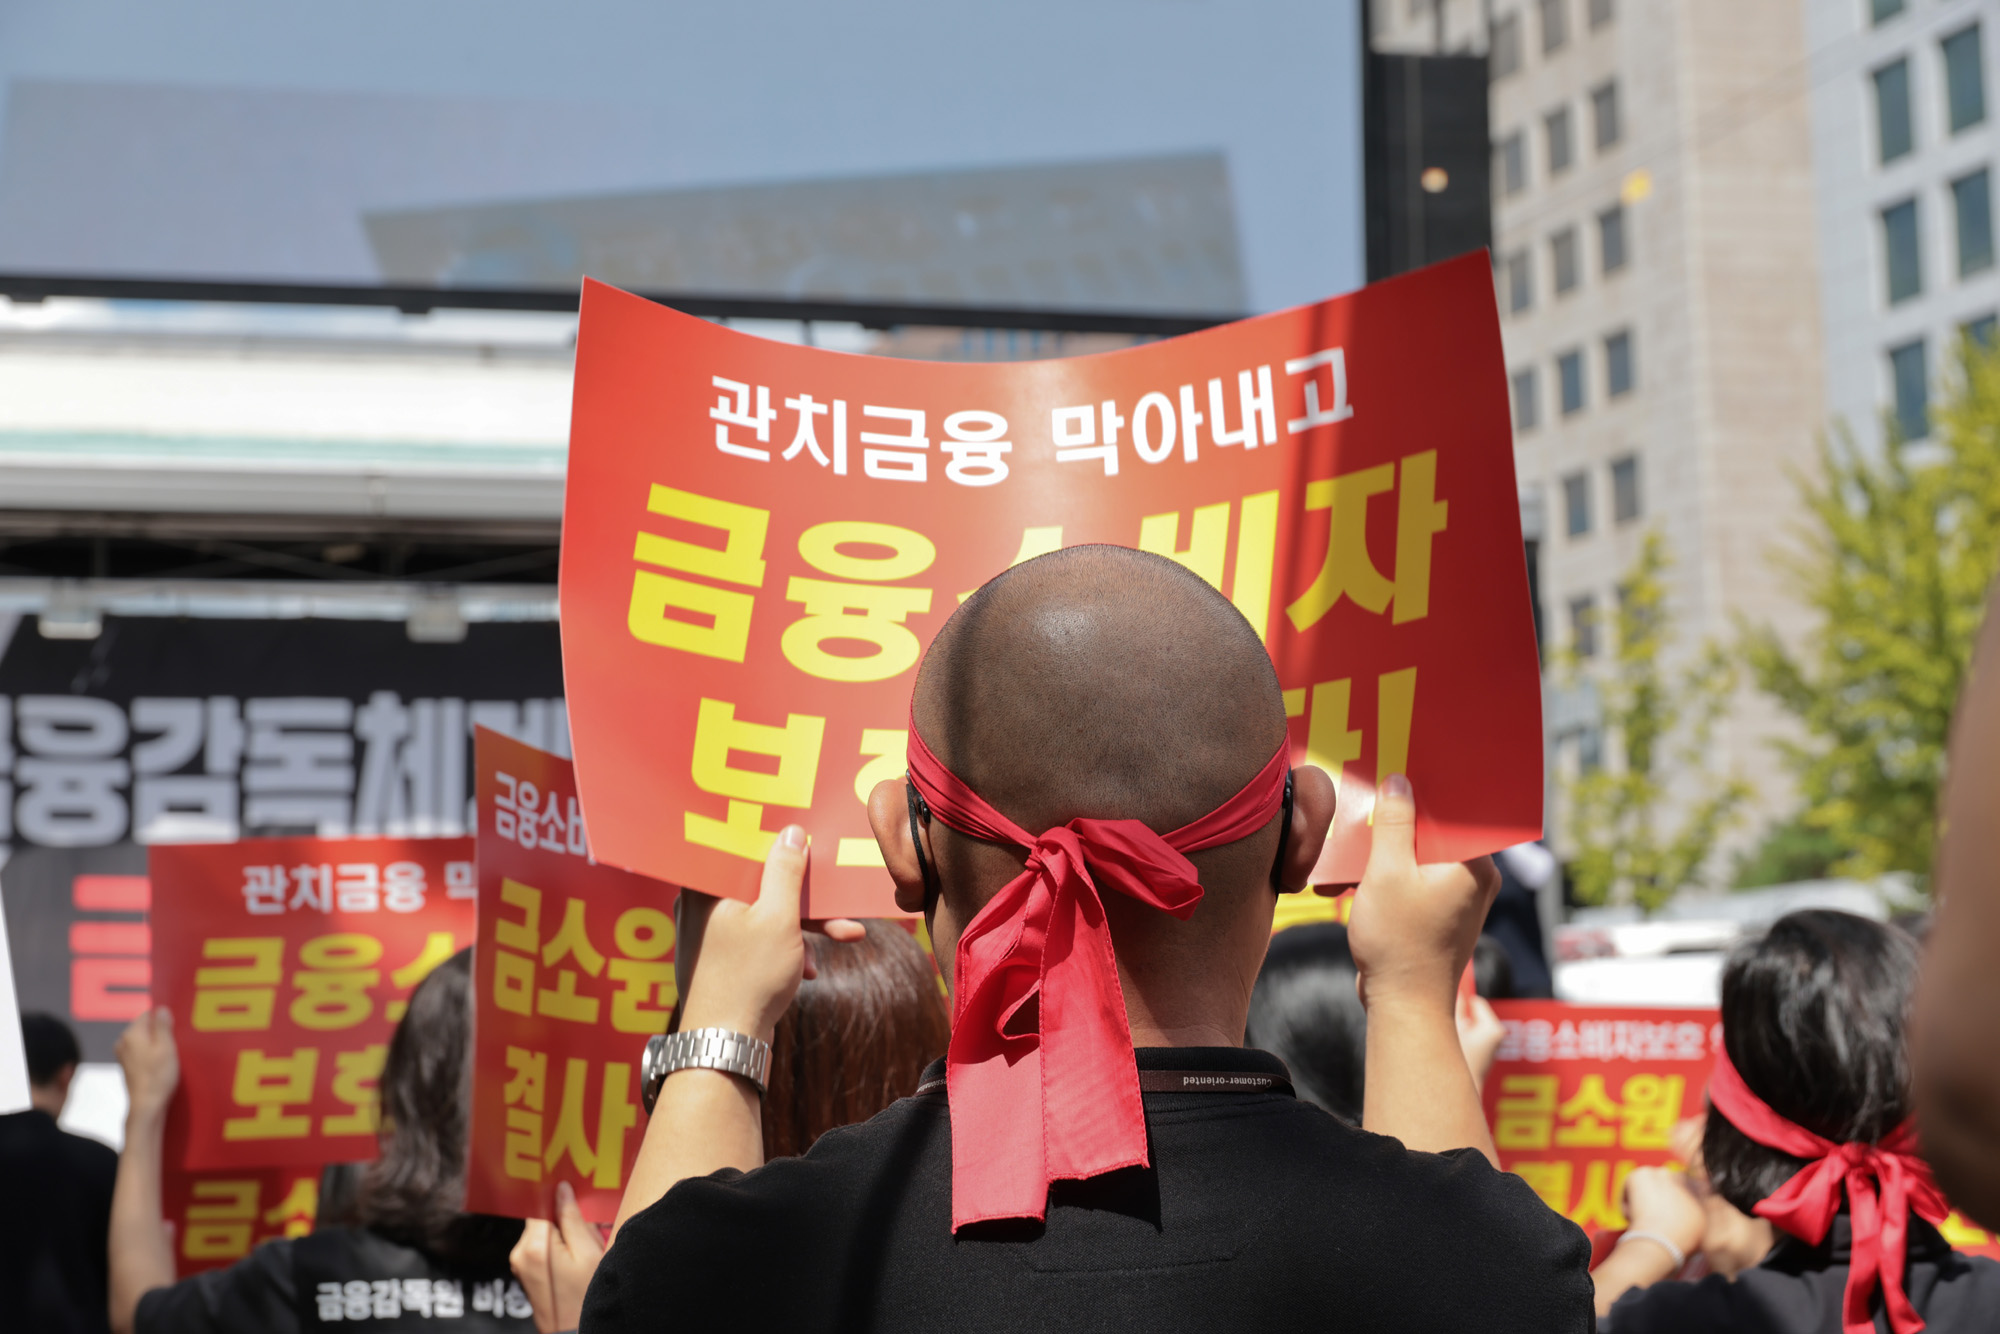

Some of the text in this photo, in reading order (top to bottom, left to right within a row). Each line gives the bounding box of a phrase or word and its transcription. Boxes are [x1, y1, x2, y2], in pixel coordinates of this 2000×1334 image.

[709, 346, 1355, 486] 관치금융 막아내고
[627, 449, 1448, 682] 금융비자
[242, 862, 428, 915] 관치금융
[1495, 1073, 1686, 1150] 금소원
[315, 1277, 465, 1321] 금융감독원
